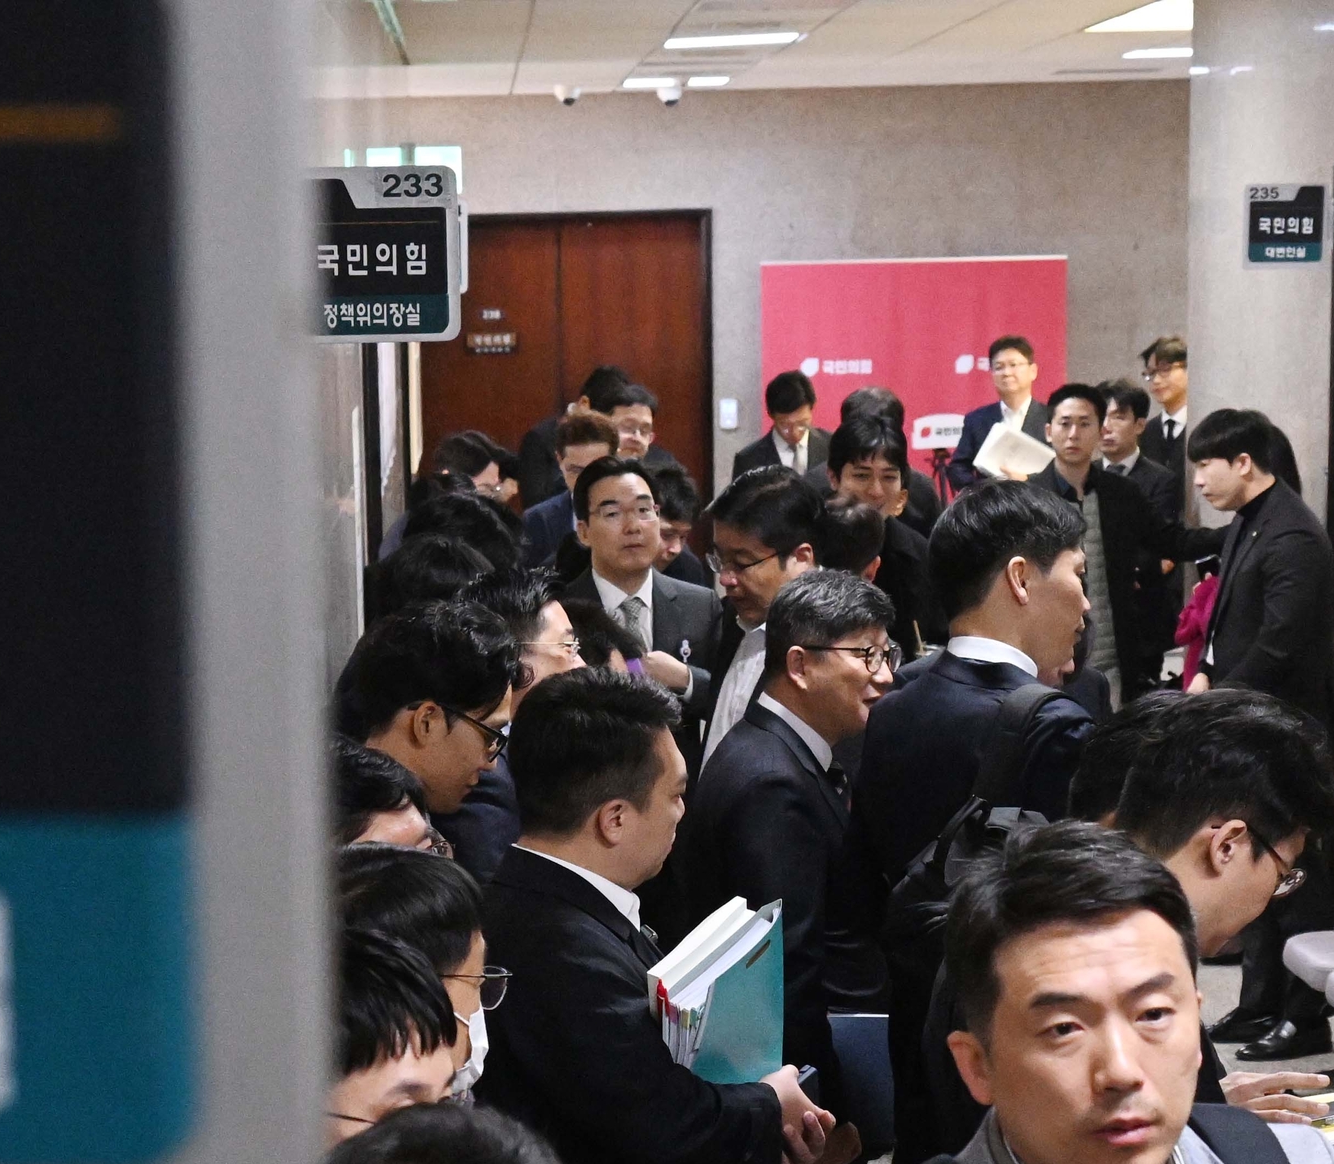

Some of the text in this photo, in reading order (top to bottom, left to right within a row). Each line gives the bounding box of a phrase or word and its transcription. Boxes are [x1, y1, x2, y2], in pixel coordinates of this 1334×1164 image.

[382, 173, 444, 198] 233
[1249, 187, 1280, 200] 235
[1258, 216, 1314, 235] 국민의힘
[317, 242, 427, 276] 국민의힘
[1264, 246, 1307, 259] 대변인실
[323, 302, 421, 328] 정책위의장실
